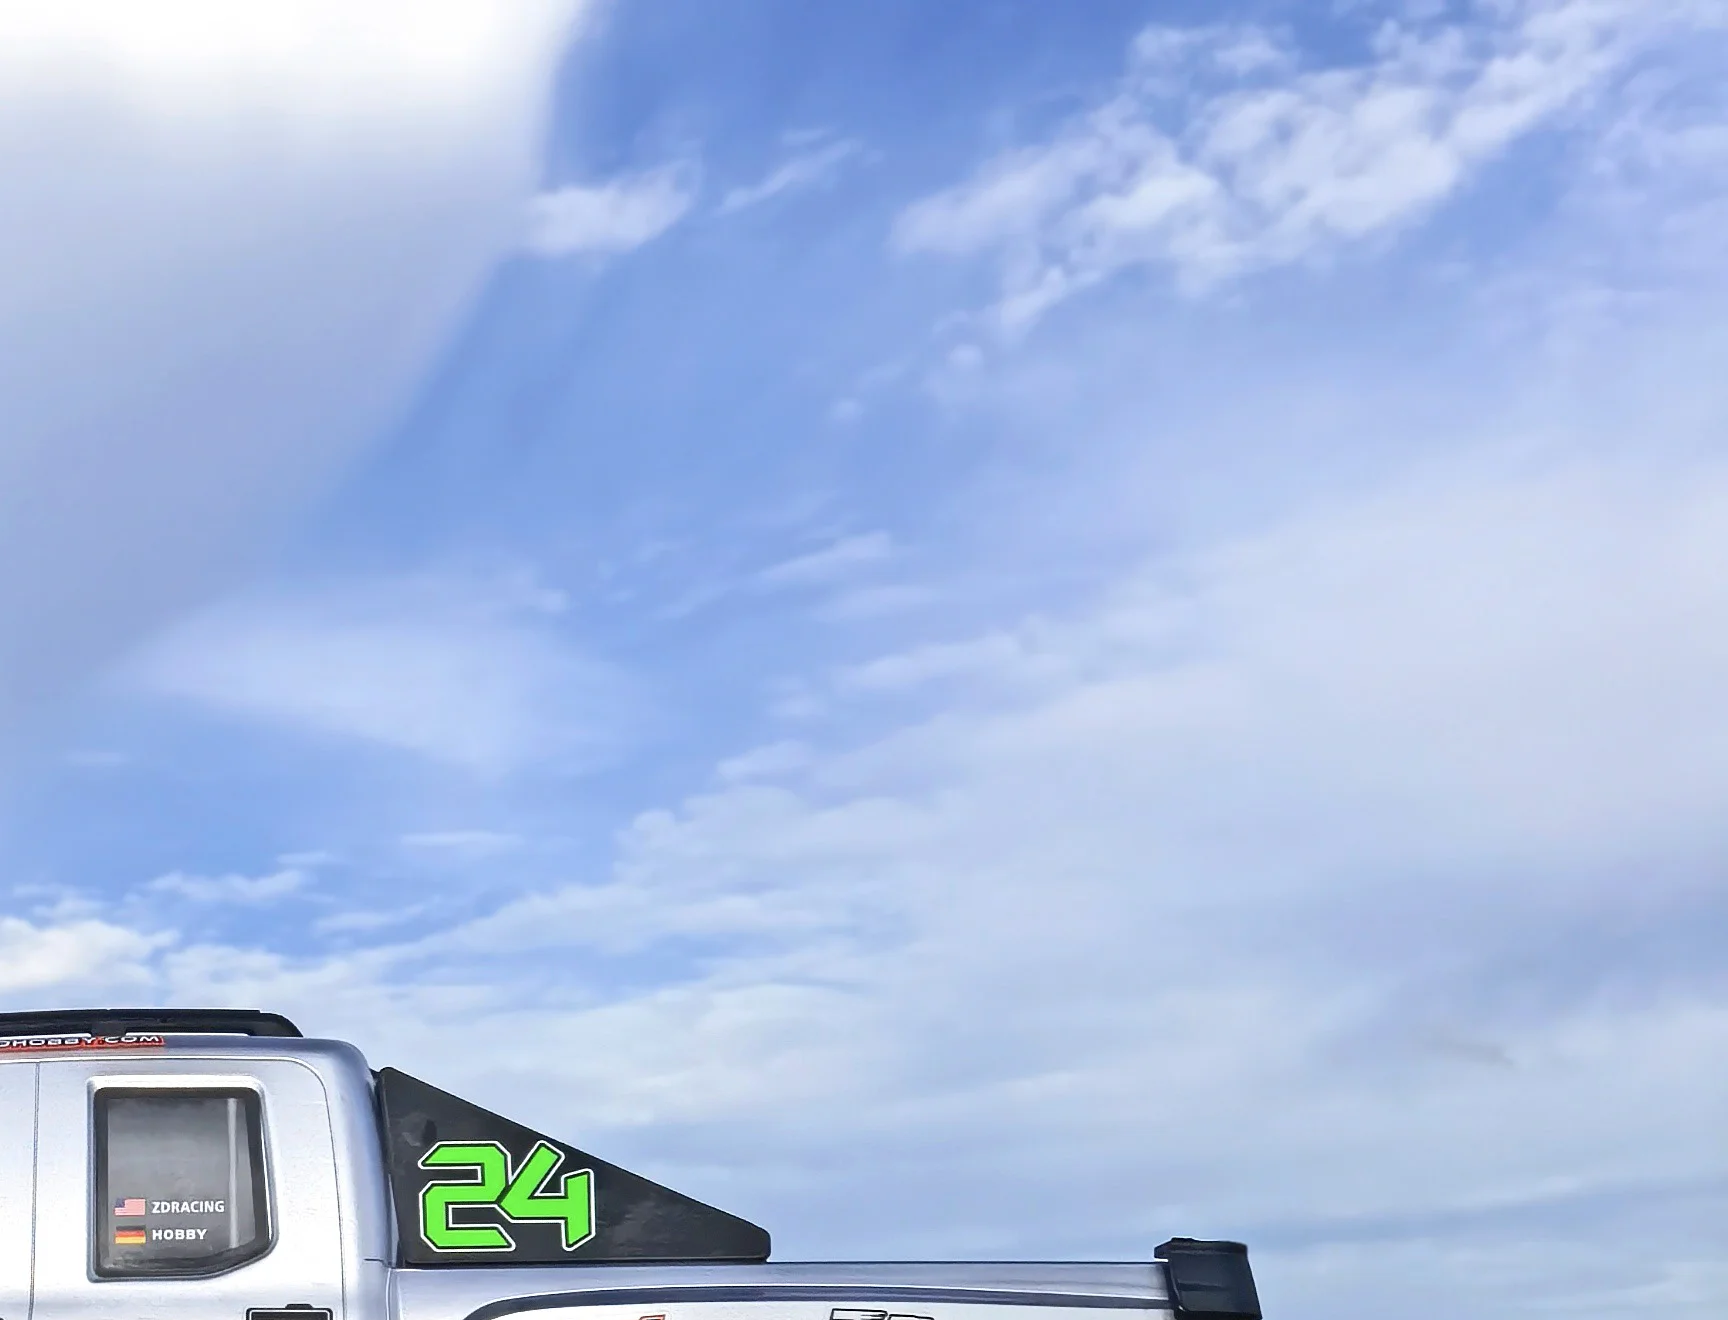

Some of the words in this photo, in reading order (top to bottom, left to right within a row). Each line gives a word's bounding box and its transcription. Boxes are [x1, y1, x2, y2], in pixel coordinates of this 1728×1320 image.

[419, 1141, 595, 1252] 24
[152, 1200, 225, 1214] ZDRACING
[152, 1228, 208, 1241] HOBBY
